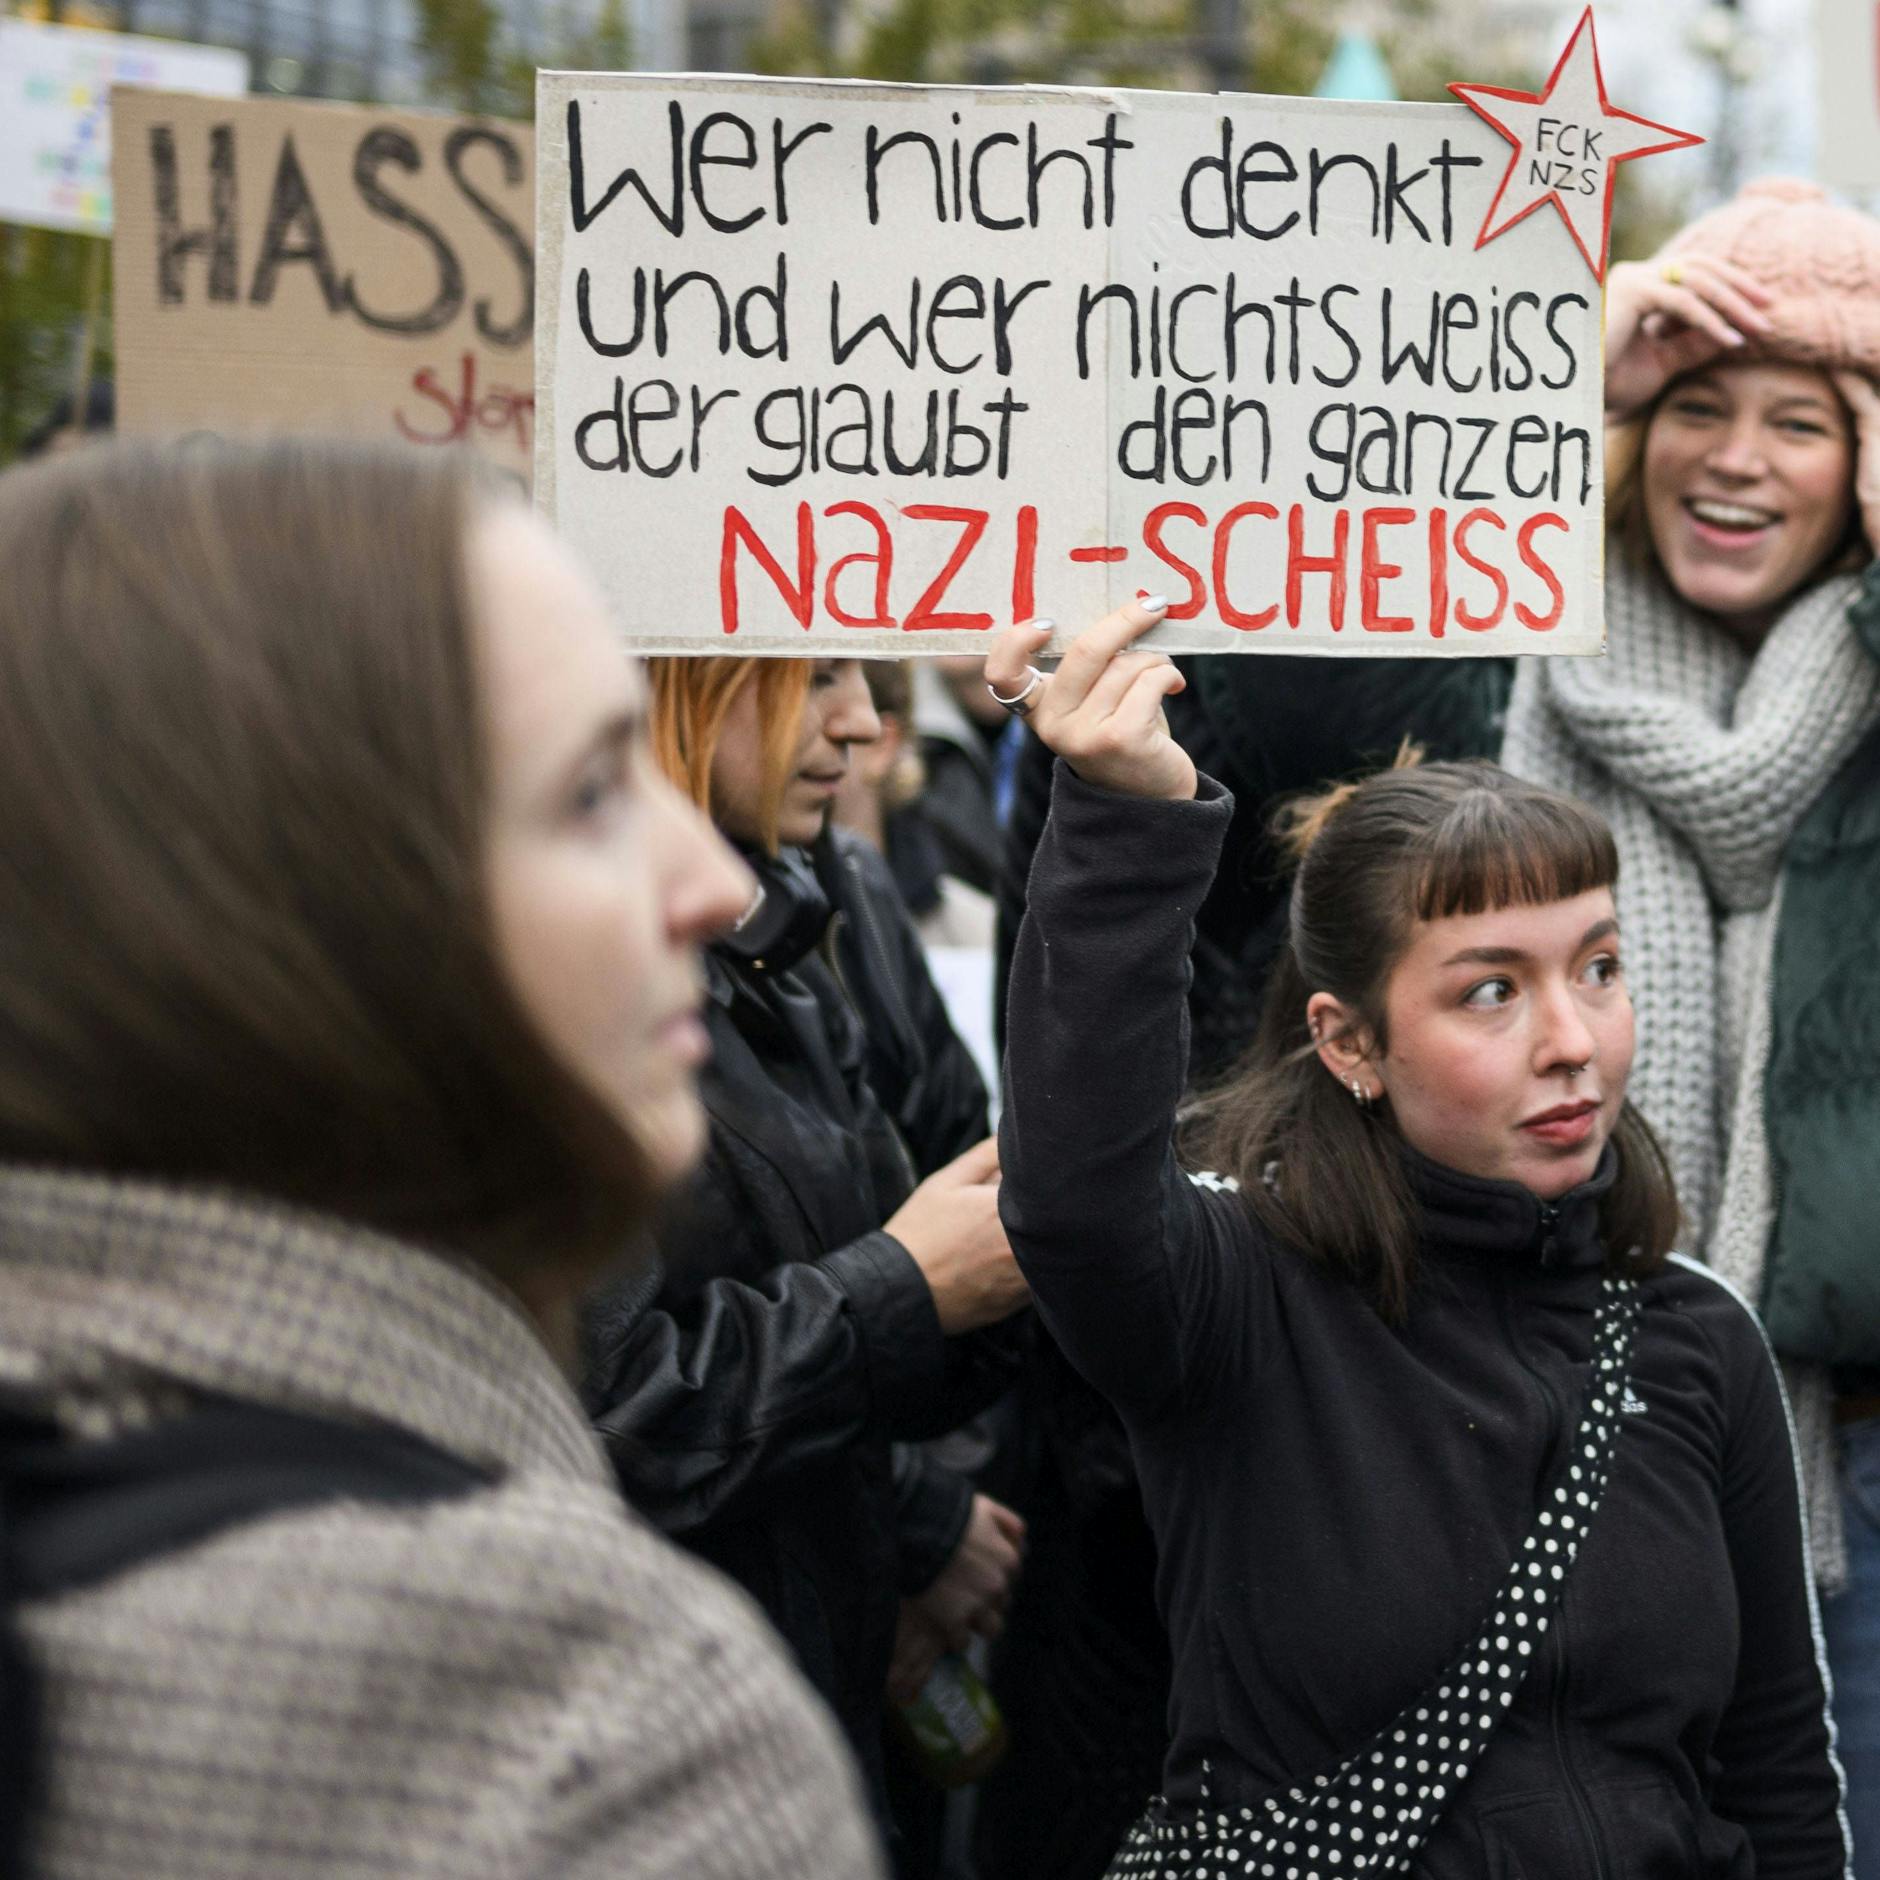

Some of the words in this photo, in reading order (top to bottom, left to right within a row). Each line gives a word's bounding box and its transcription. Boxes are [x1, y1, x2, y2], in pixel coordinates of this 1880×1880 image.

[567, 100, 833, 237] Wer
[865, 112, 1134, 230] nicht
[1180, 116, 1483, 247] denkt
[1529, 159, 1598, 196] NZS
[1536, 118, 1603, 161] FCK
[576, 251, 788, 362] und
[830, 274, 1051, 377] wer
[574, 375, 740, 479] der
[747, 383, 1029, 488] glaubt
[1117, 384, 1272, 486] den
[1306, 402, 1592, 506] ganzen
